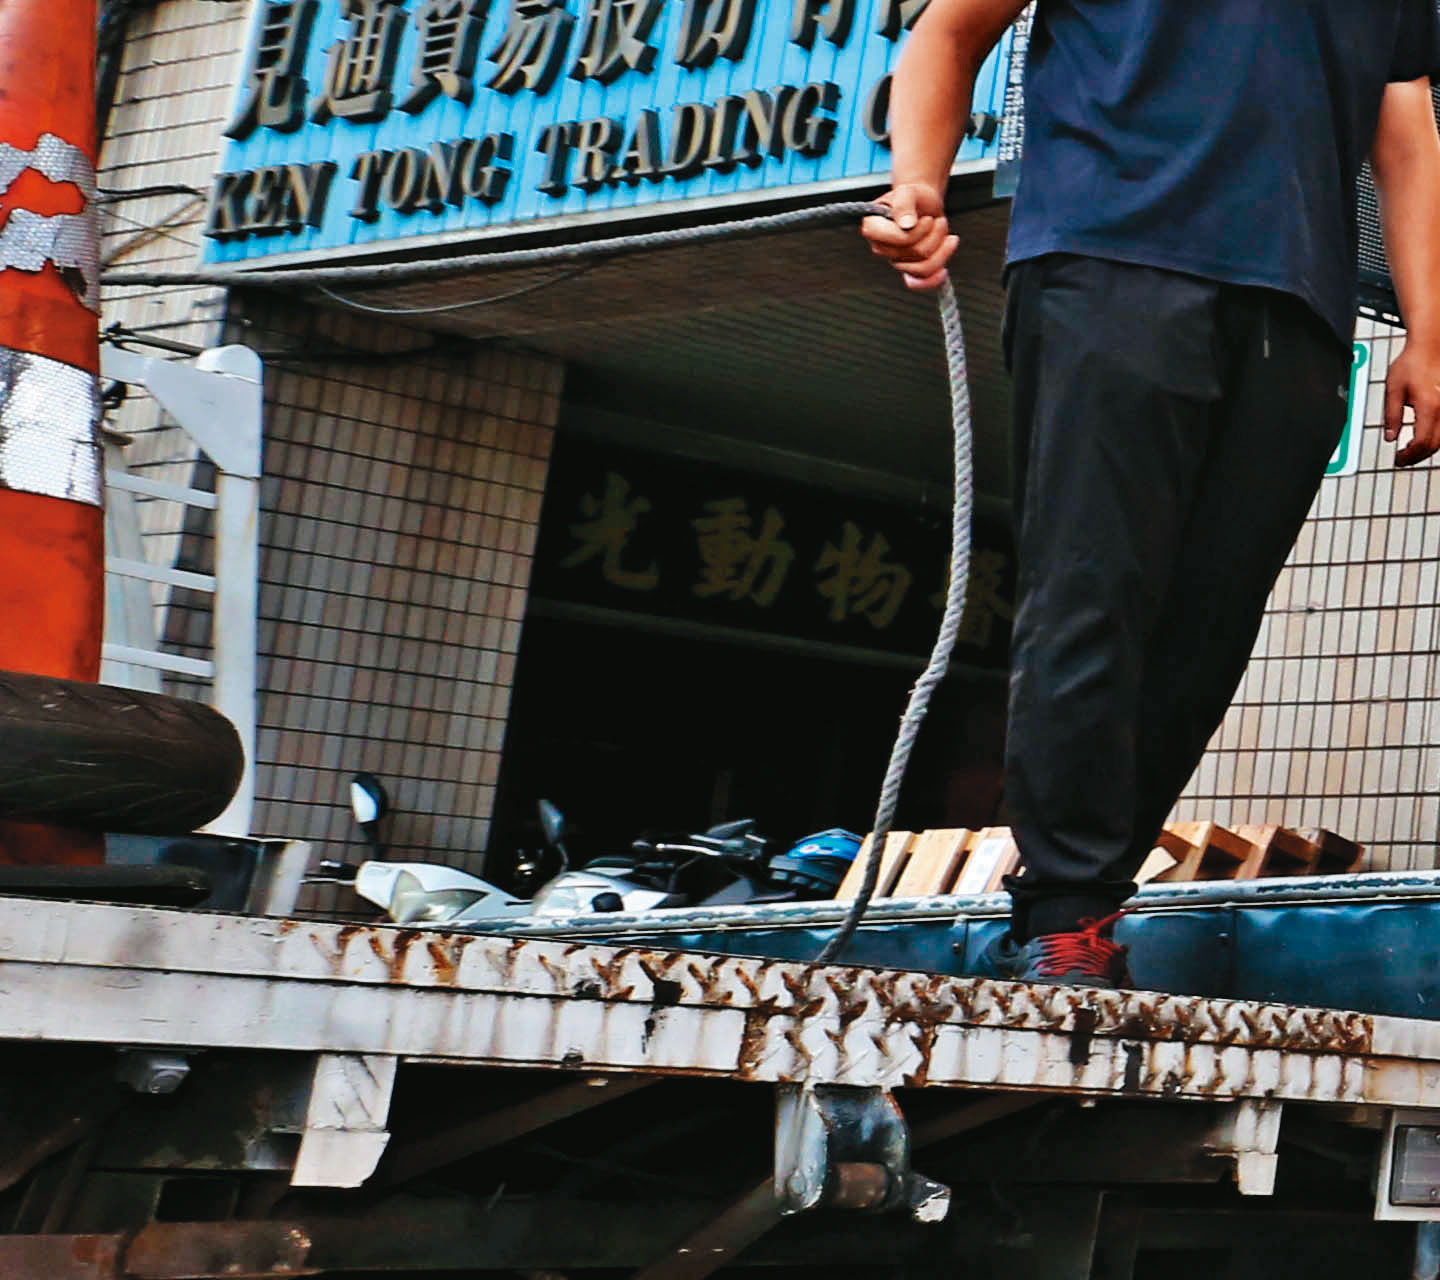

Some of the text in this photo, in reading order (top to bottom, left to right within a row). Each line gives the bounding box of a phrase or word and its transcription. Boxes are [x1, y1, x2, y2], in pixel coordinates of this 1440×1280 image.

[204, 160, 337, 242] KEN
[348, 132, 513, 220] TONG
[534, 80, 840, 195] TRADING
